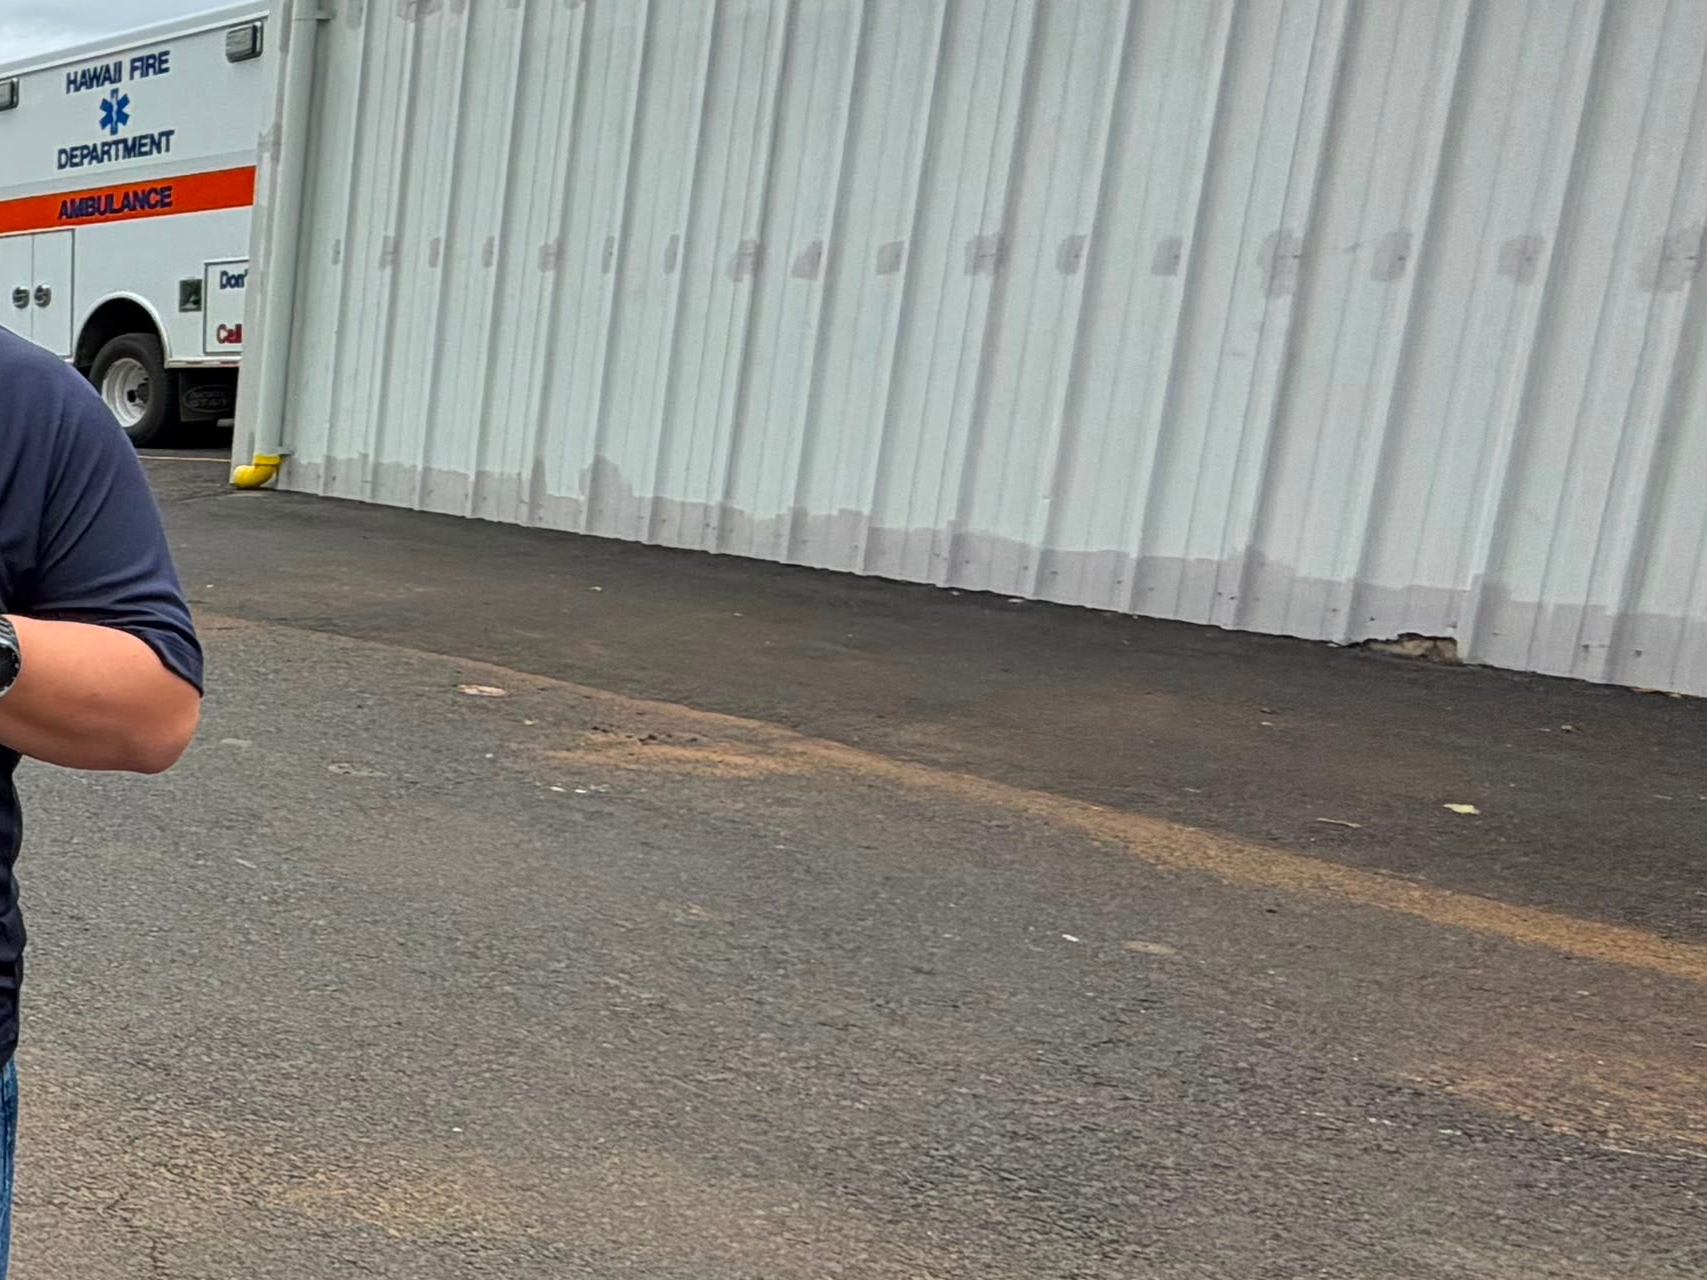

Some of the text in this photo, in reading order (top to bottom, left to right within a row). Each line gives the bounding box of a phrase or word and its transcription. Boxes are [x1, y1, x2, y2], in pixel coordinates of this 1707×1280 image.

[65, 50, 171, 94] HAWAII FIRE
[57, 129, 175, 170] DEPARTMENT
[58, 185, 173, 221] AMBULANCE
[219, 269, 249, 290] Don'
